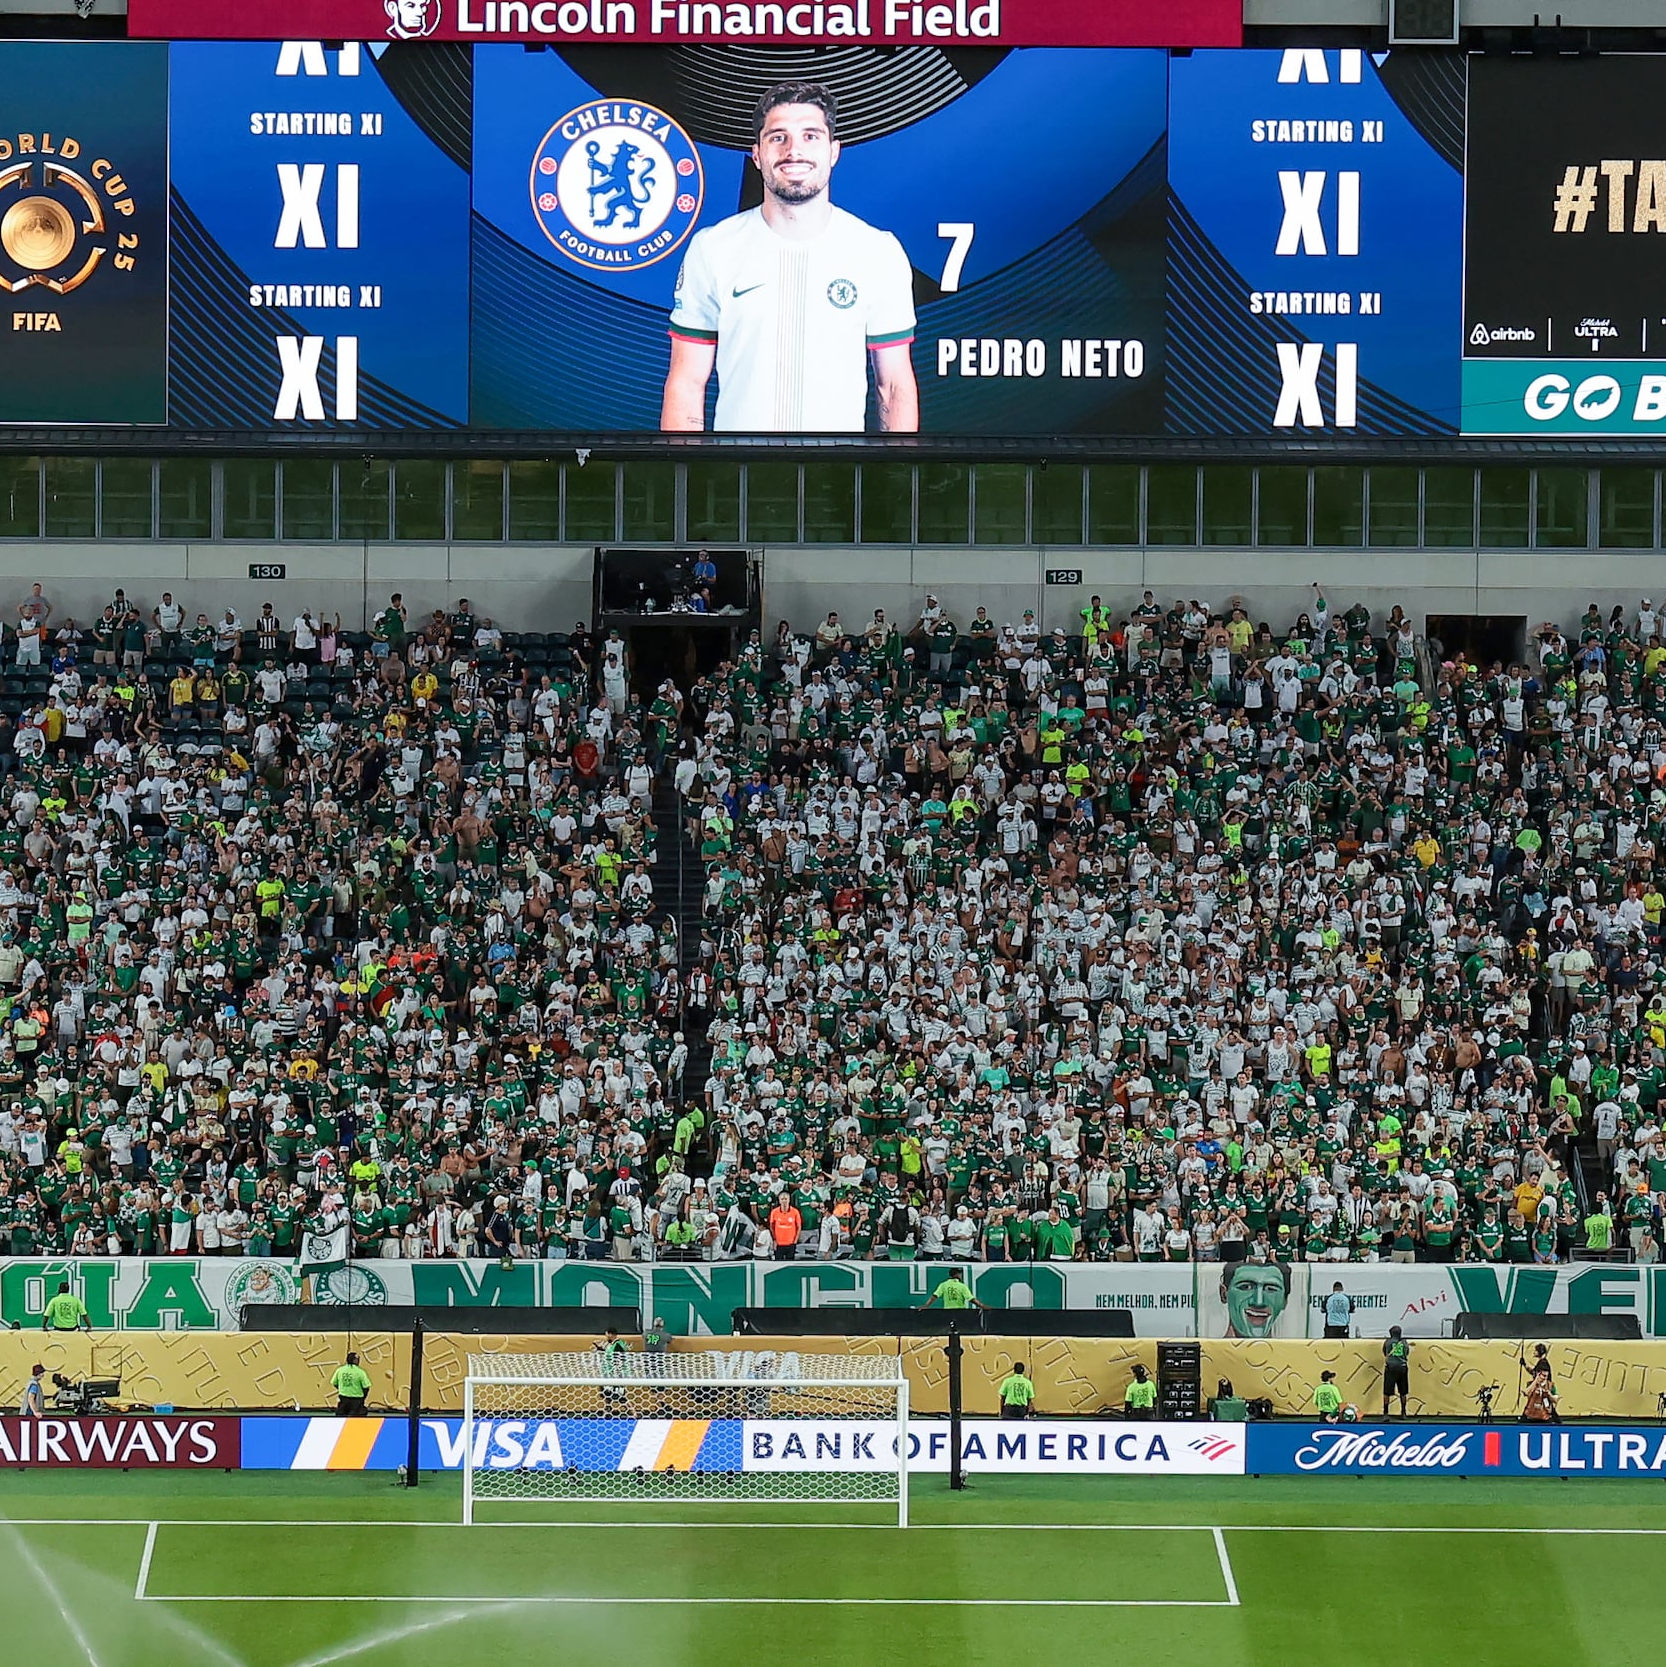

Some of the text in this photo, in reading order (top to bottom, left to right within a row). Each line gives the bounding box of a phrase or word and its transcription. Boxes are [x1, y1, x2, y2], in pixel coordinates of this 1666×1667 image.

[250, 113, 382, 135] STARTING XI
[561, 102, 672, 143] CHELSEA
[1252, 120, 1383, 142] STARTING XI
[91, 157, 135, 218] CUP
[113, 232, 139, 274] 25
[274, 163, 359, 249] XI
[1275, 171, 1360, 255] XI
[558, 228, 674, 262] FOOTBALL CLUB
[937, 223, 975, 292] 7
[250, 285, 380, 308] STARTING XI
[1250, 292, 1381, 314] STARTING XI
[13, 312, 61, 332] FIFA
[1491, 329, 1535, 341] airbnb
[1575, 326, 1618, 337] ULTRA
[937, 338, 1144, 378] PEDRO NETO
[273, 336, 358, 420] XI
[1273, 343, 1358, 427] XI
[1524, 375, 1622, 423] GO
[253, 565, 280, 578] 130
[1050, 571, 1078, 584] 129
[1096, 1295, 1115, 1308] NEM
[1117, 1295, 1157, 1310] MELHOR,
[1159, 1295, 1179, 1308] NEM
[707, 1350, 800, 1380] VISA
[421, 1421, 564, 1469] VISA
[753, 1431, 1172, 1462] BANK OF AMERICA
[1294, 1430, 1467, 1469] Michelob
